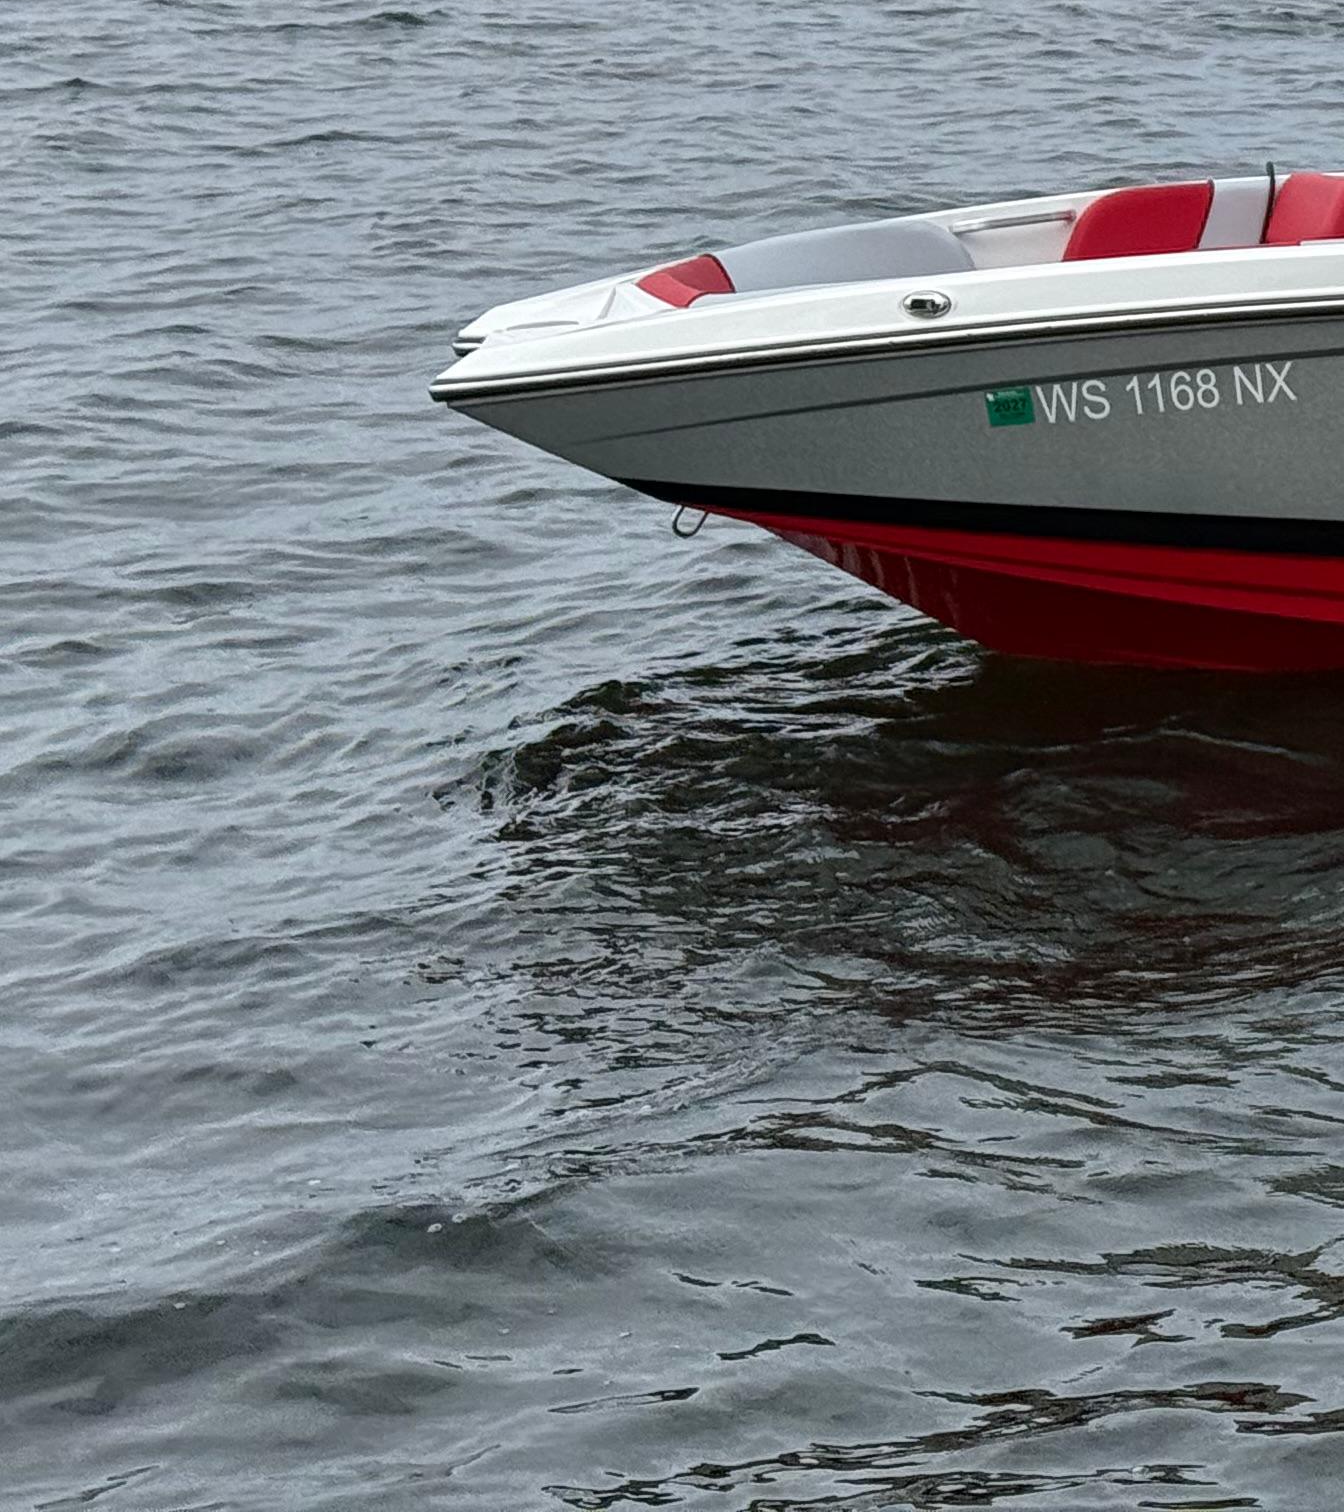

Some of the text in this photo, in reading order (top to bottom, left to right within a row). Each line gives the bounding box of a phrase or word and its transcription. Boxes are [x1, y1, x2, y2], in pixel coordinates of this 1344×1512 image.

[1035, 361, 1297, 423] WS 1168 NX
